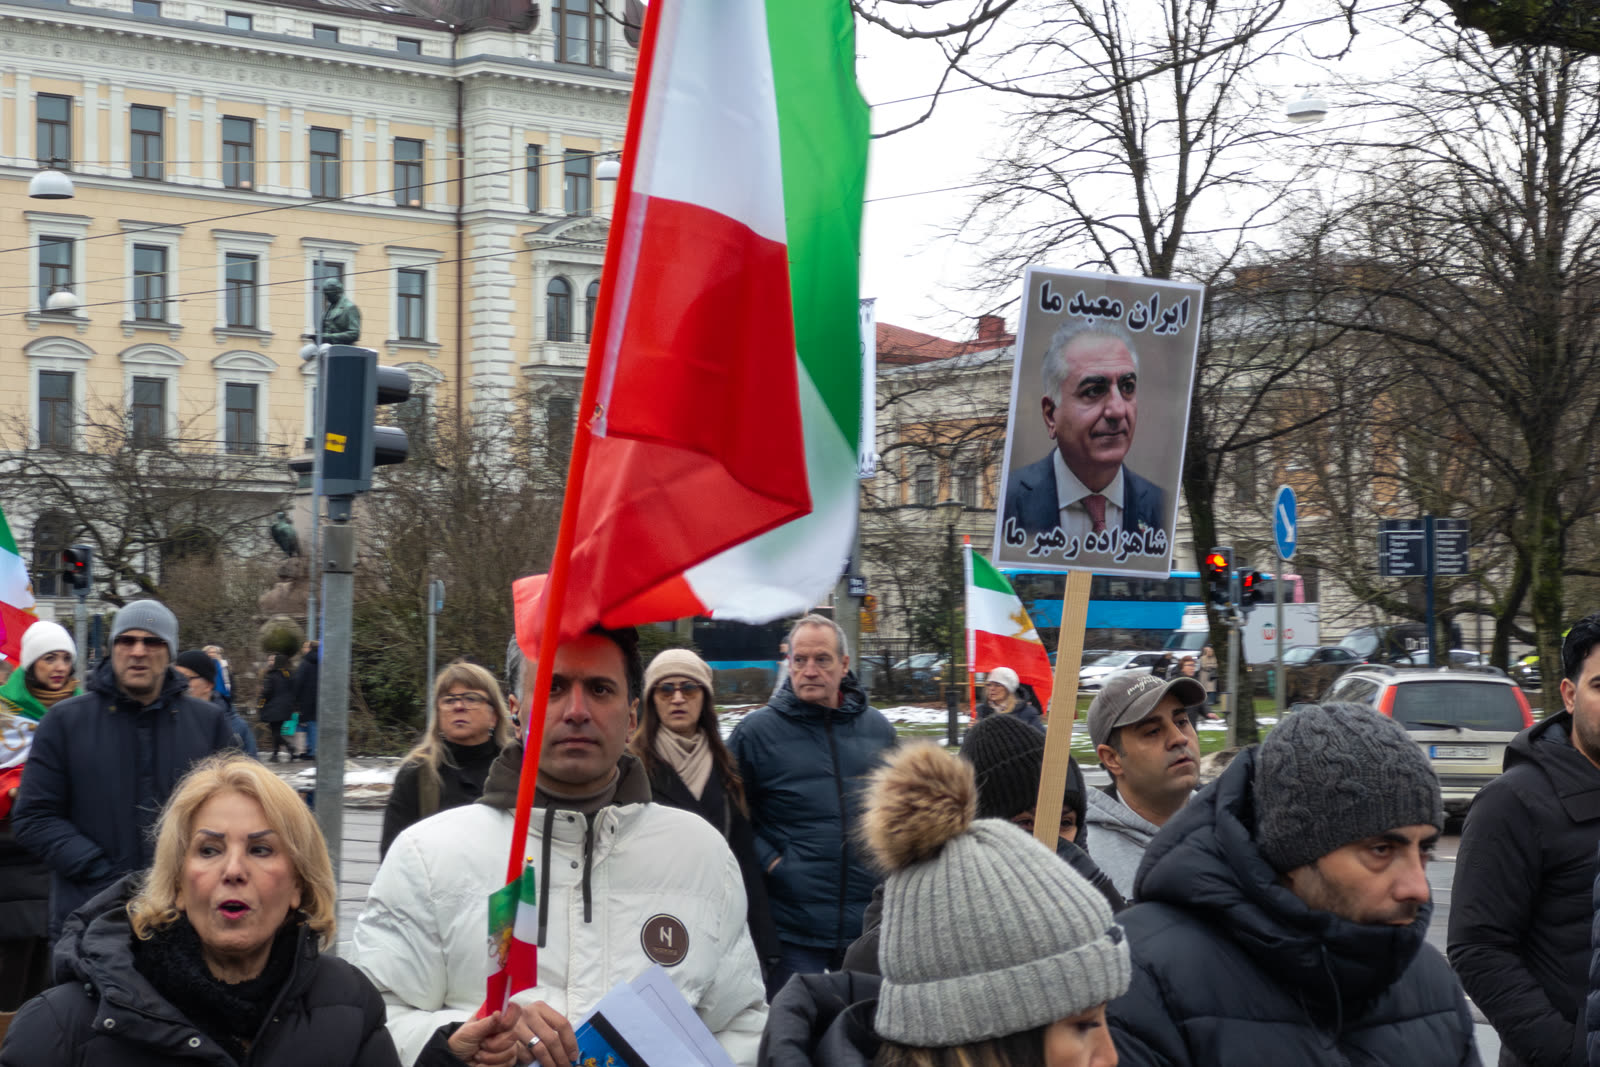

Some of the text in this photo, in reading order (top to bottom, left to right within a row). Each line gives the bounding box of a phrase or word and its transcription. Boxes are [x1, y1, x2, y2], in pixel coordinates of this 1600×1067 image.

[1040, 280, 1190, 335] ایران معبد ما
[1005, 517, 1168, 563] شاهزاده رهبر ما
